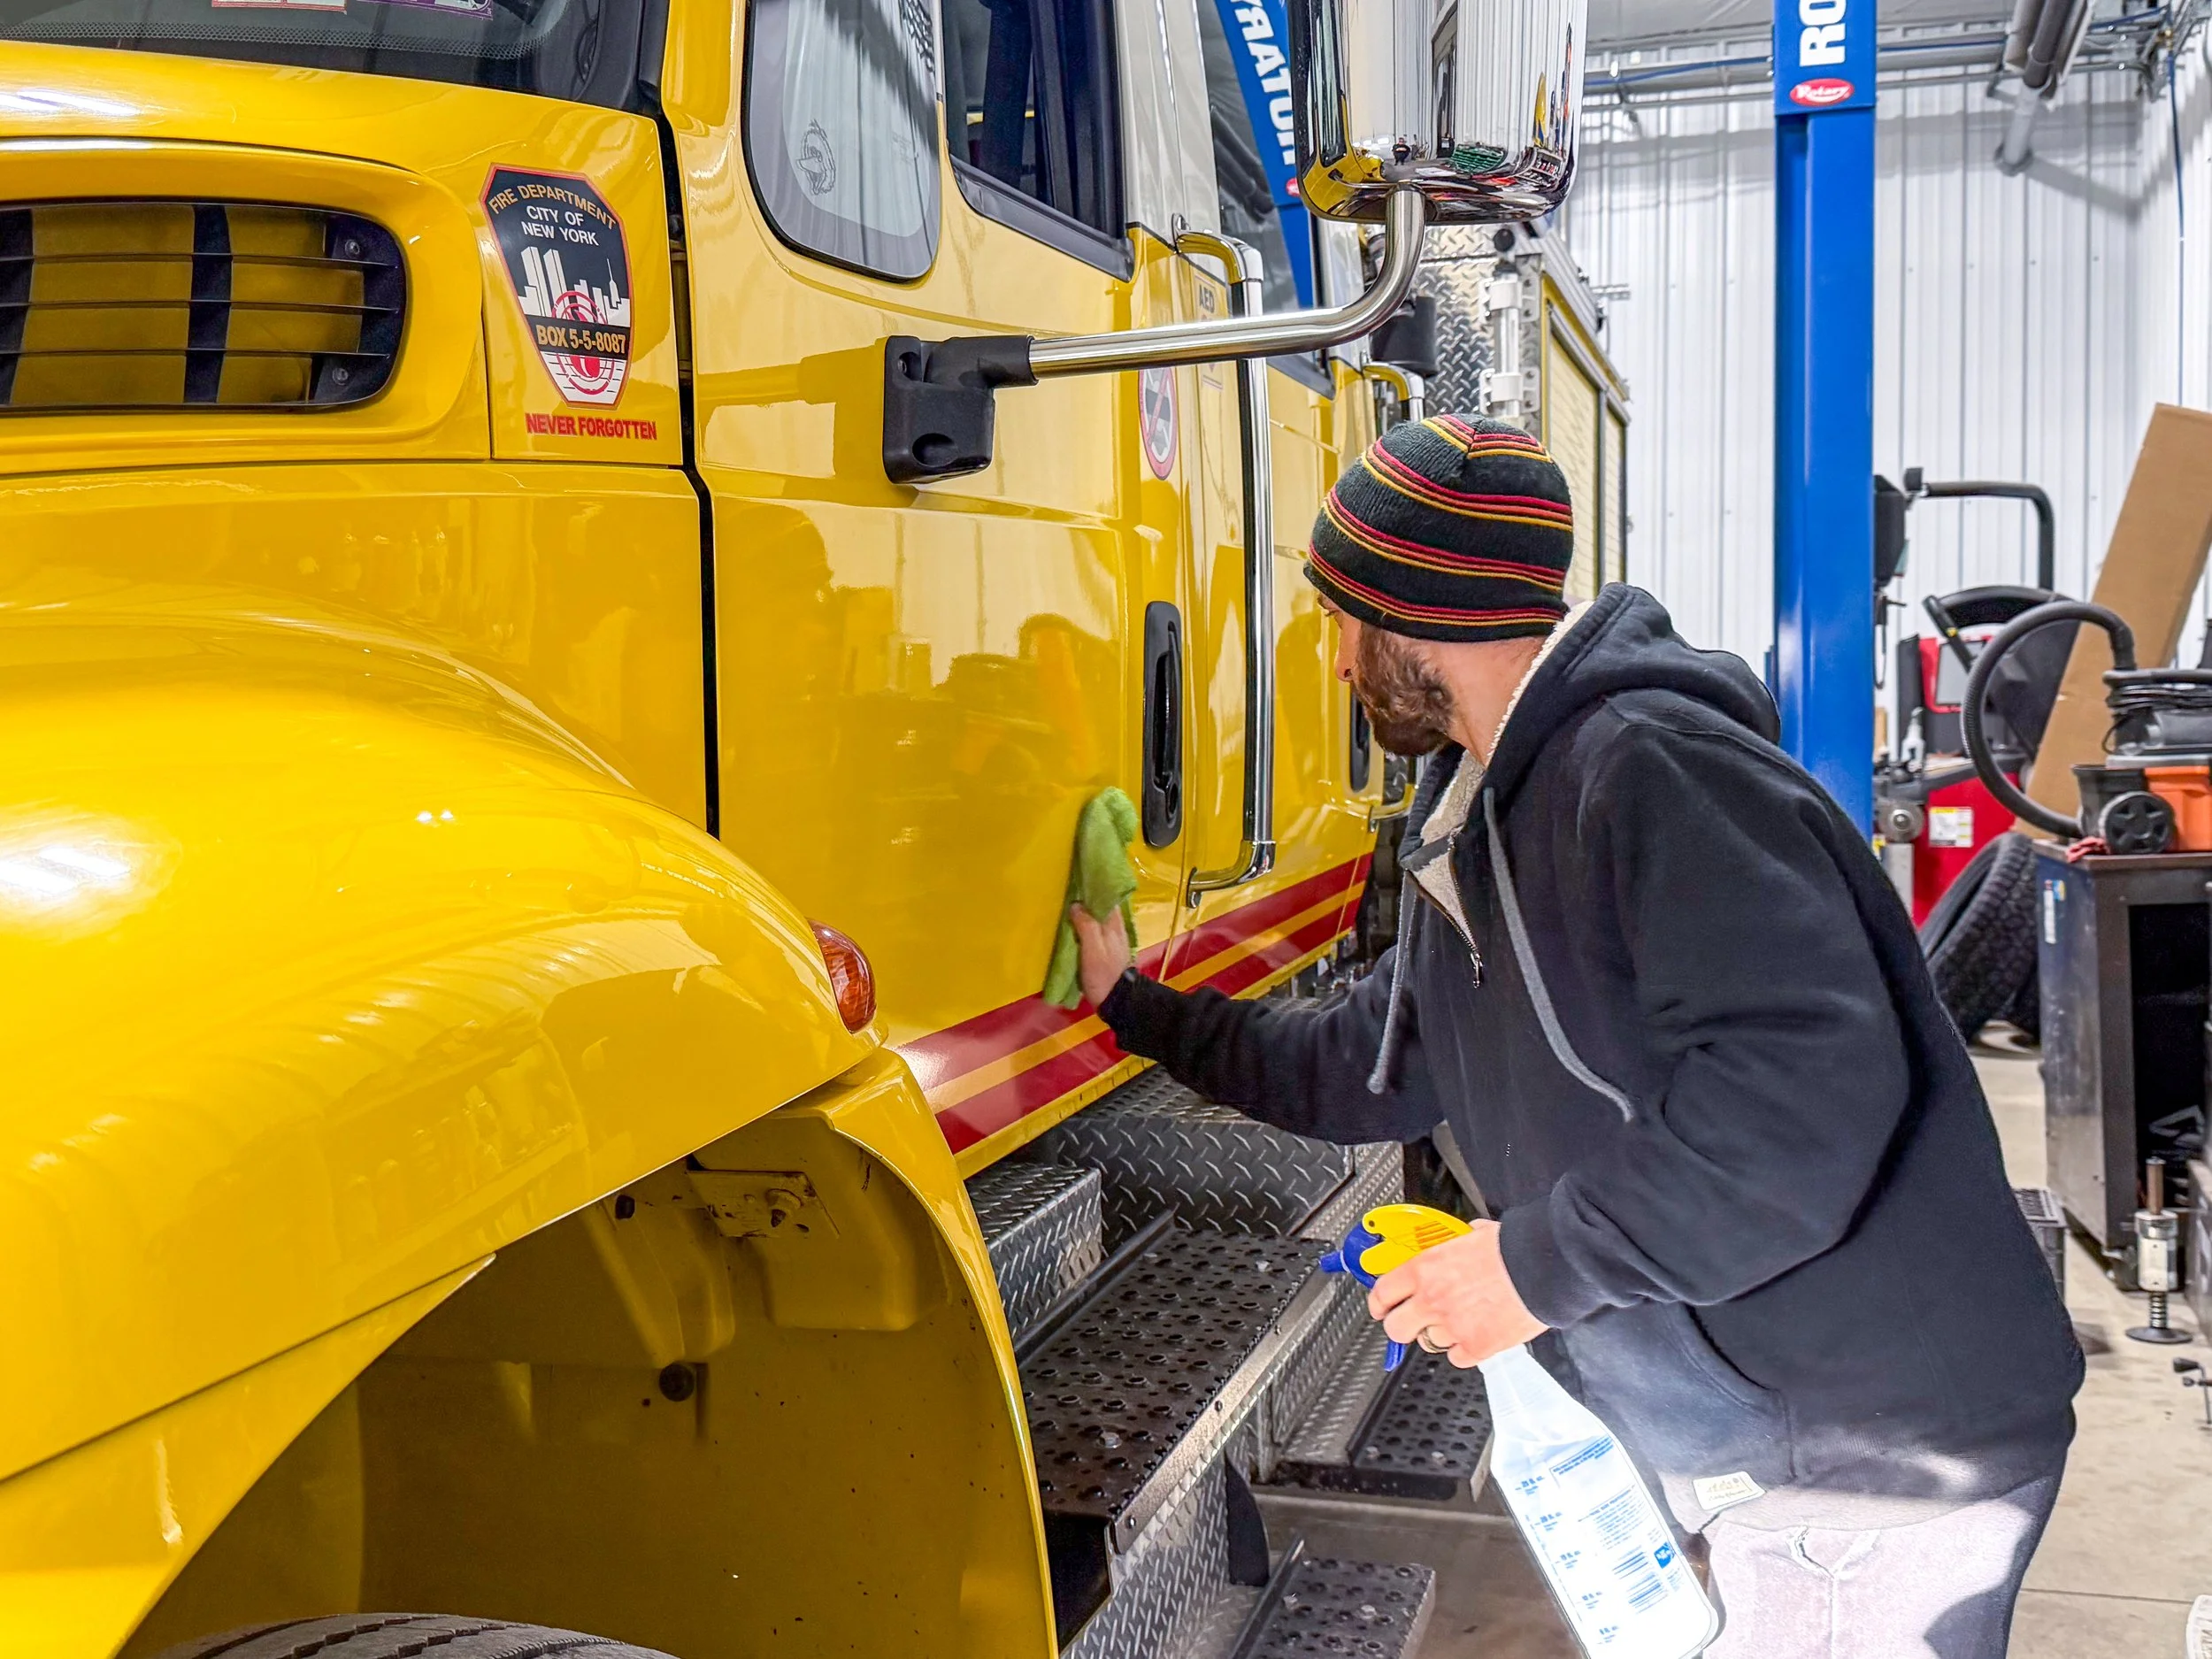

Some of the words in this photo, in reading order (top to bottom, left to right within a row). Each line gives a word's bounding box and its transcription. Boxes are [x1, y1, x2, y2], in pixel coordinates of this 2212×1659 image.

[1799, 0, 1847, 67] RO
[488, 188, 518, 214] FIRE
[518, 184, 617, 230] DEPARTMENT
[526, 205, 558, 223] CITY
[565, 211, 584, 227] OF
[521, 221, 555, 239] NEW
[559, 227, 599, 246] YORK
[1199, 284, 1215, 314] AED
[535, 324, 569, 348] BOX
[569, 328, 626, 354] 5-5-8087
[525, 412, 577, 436] NEVER
[578, 417, 657, 440] FORGOTTEN
